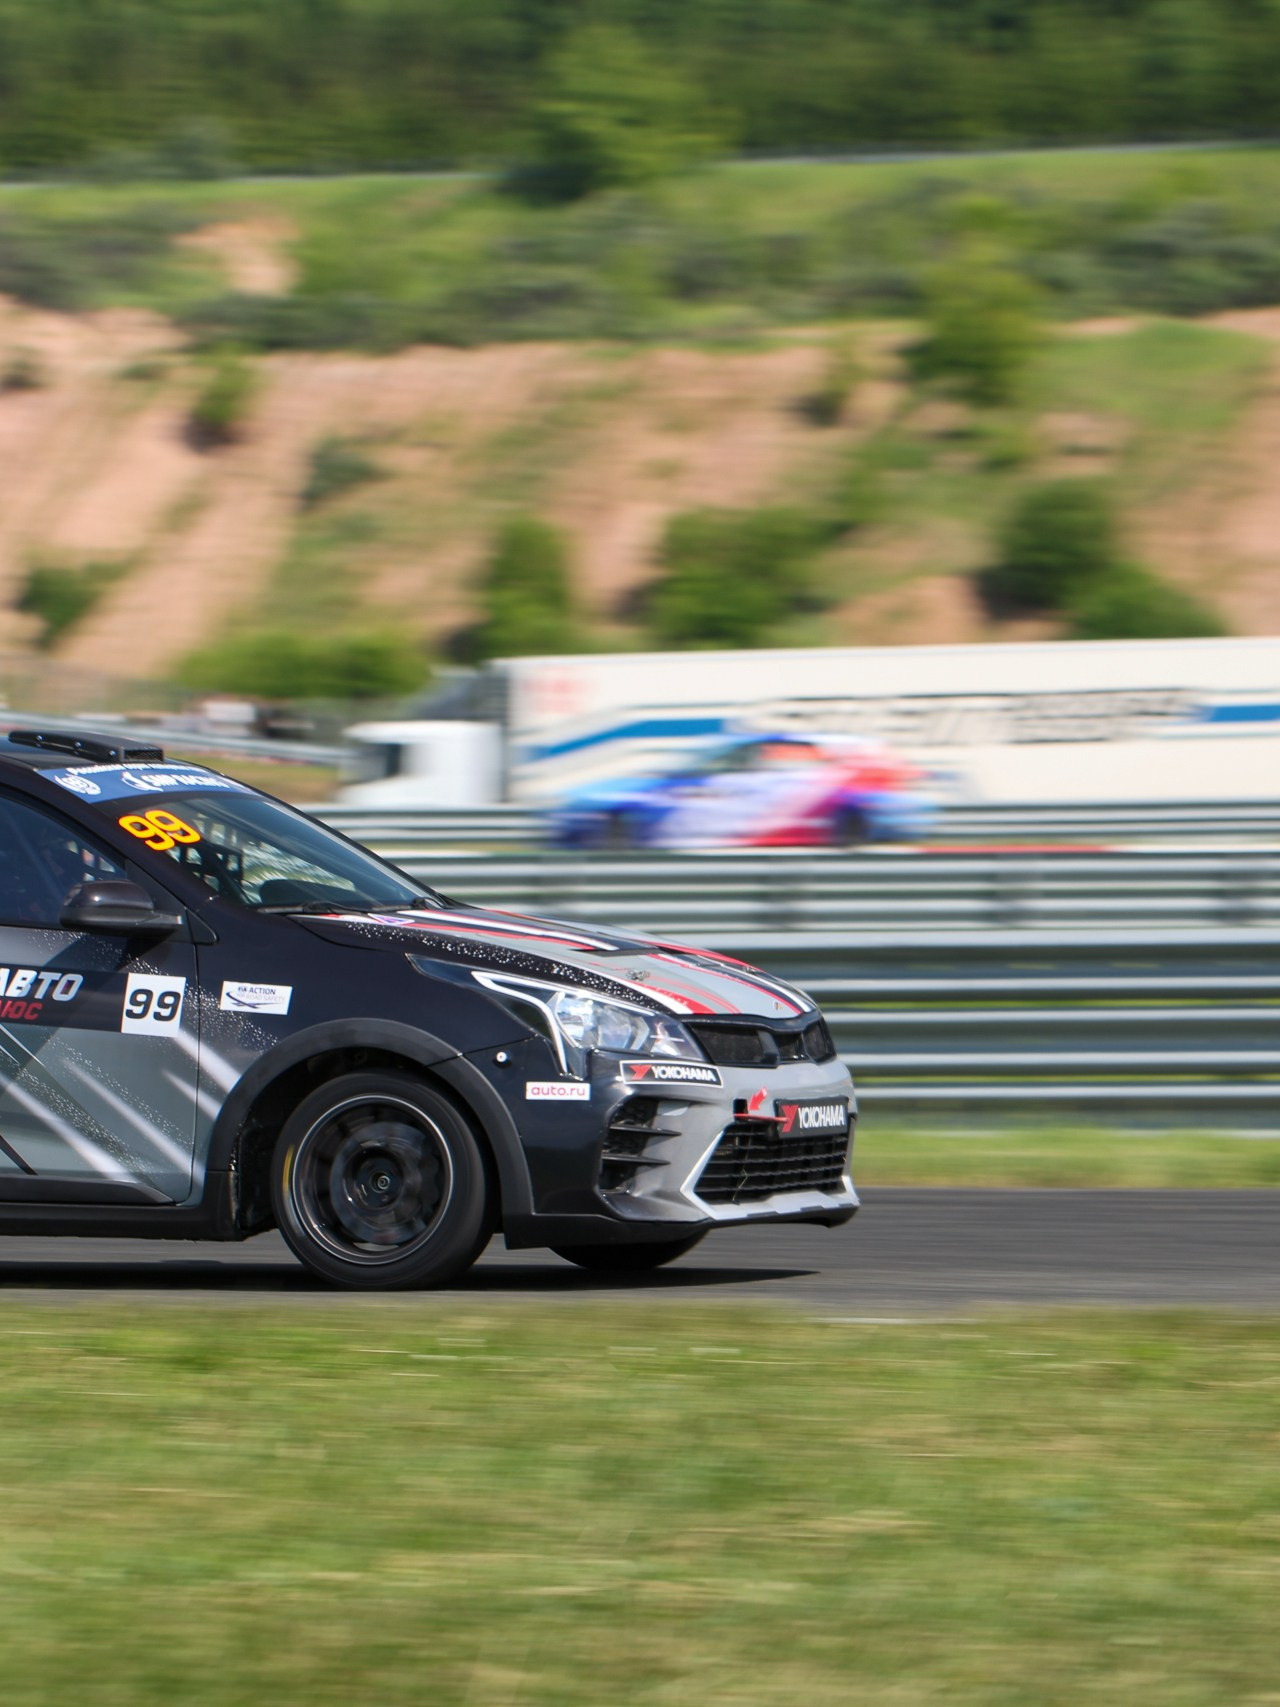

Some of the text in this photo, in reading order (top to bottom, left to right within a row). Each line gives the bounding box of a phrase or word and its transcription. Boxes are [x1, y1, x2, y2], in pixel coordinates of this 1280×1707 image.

[118, 810, 201, 850] 99
[249, 987, 276, 995] ACTION
[125, 988, 181, 1022] 99
[651, 1065, 717, 1083] YOKOHAMA
[531, 1085, 587, 1097] auto.ru
[798, 1104, 845, 1129] YOKOHAMA
